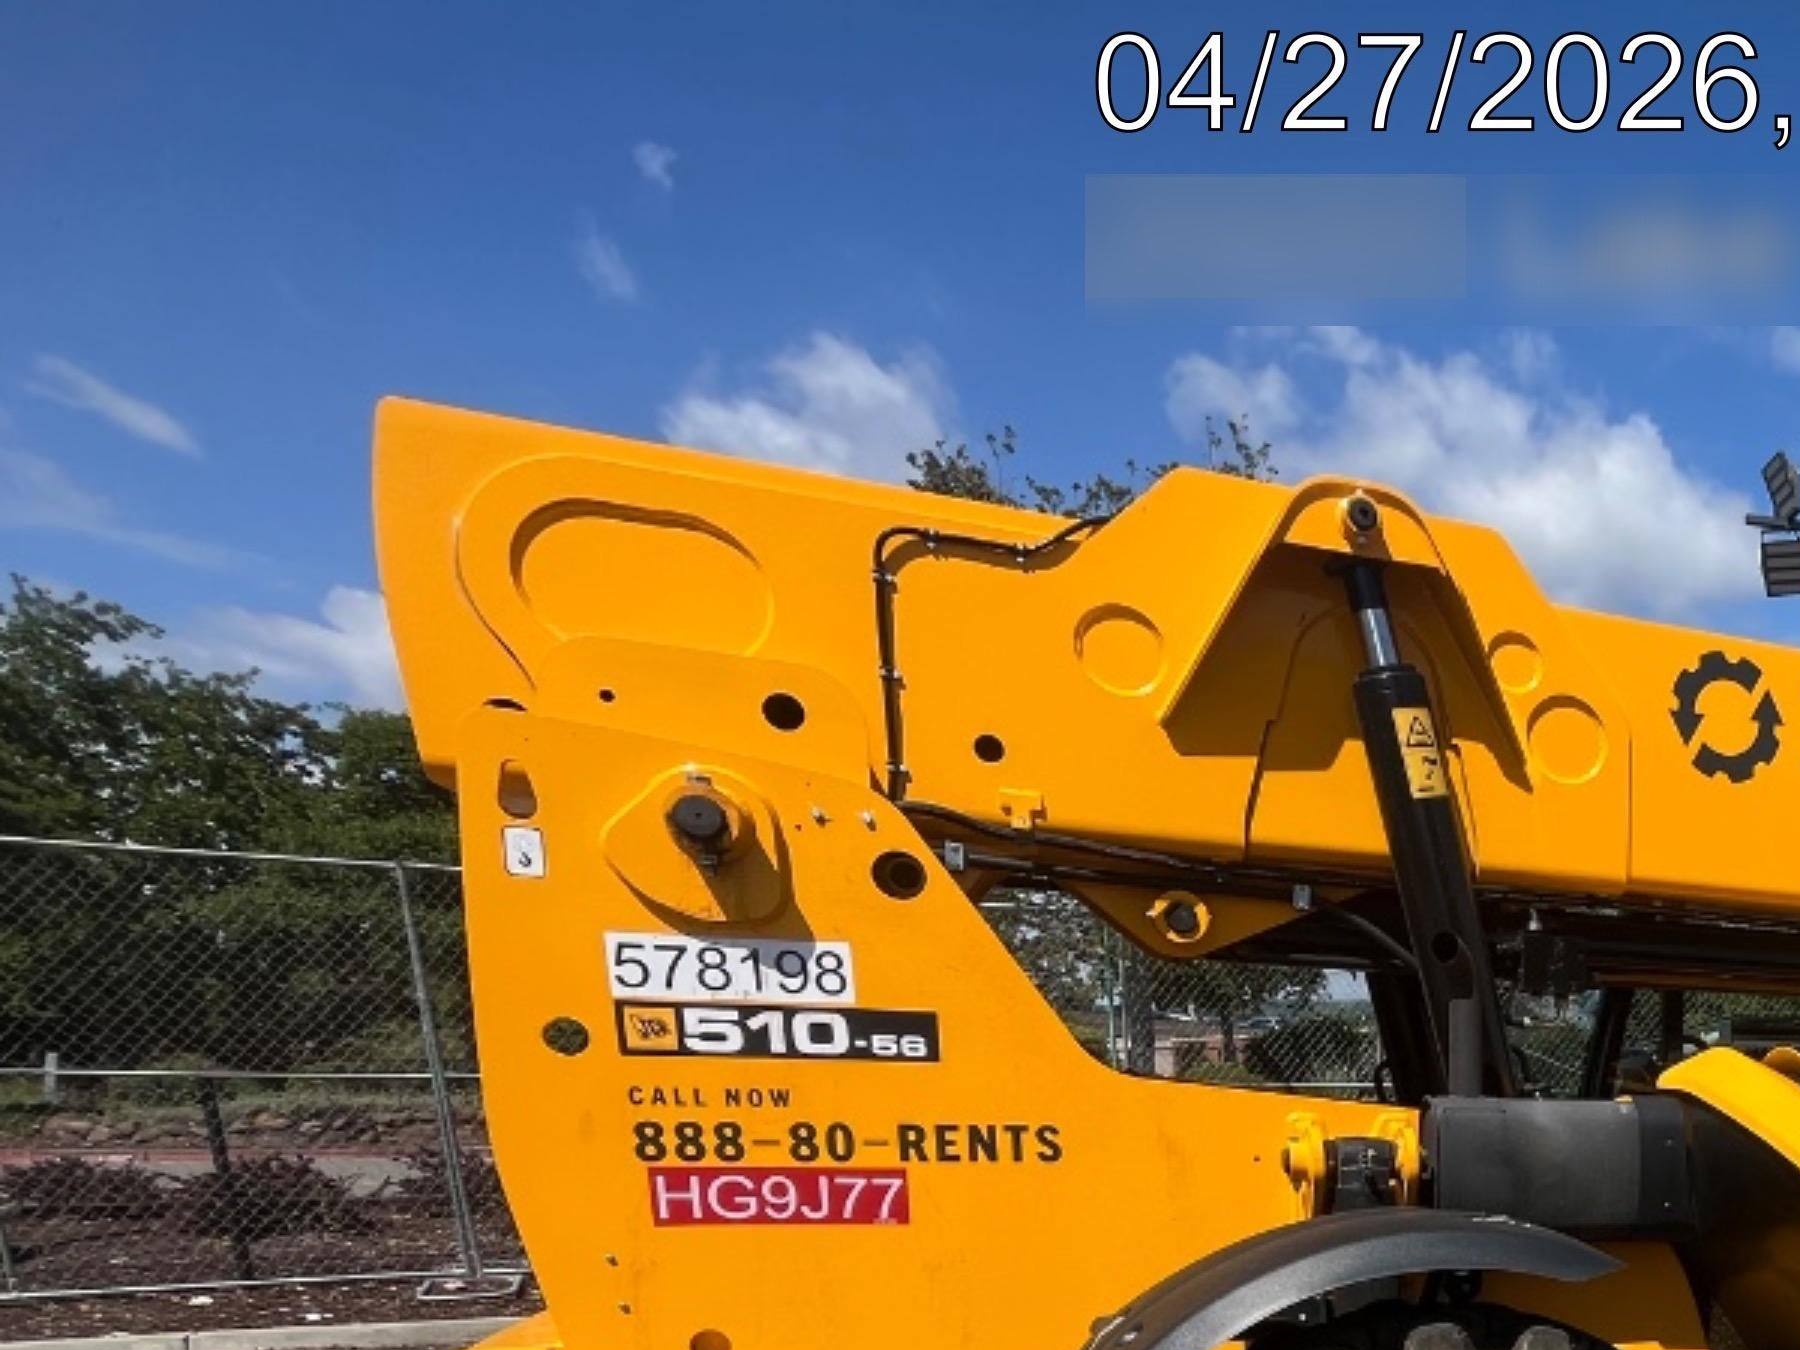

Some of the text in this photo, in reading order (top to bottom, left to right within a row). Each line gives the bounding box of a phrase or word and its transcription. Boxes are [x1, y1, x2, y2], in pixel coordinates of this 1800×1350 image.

[613, 942, 848, 995] 578198
[628, 1086, 791, 1108] CALL NOW
[633, 1121, 1063, 1162] 888-80-RENTS
[655, 1175, 904, 1220] HG9J77
